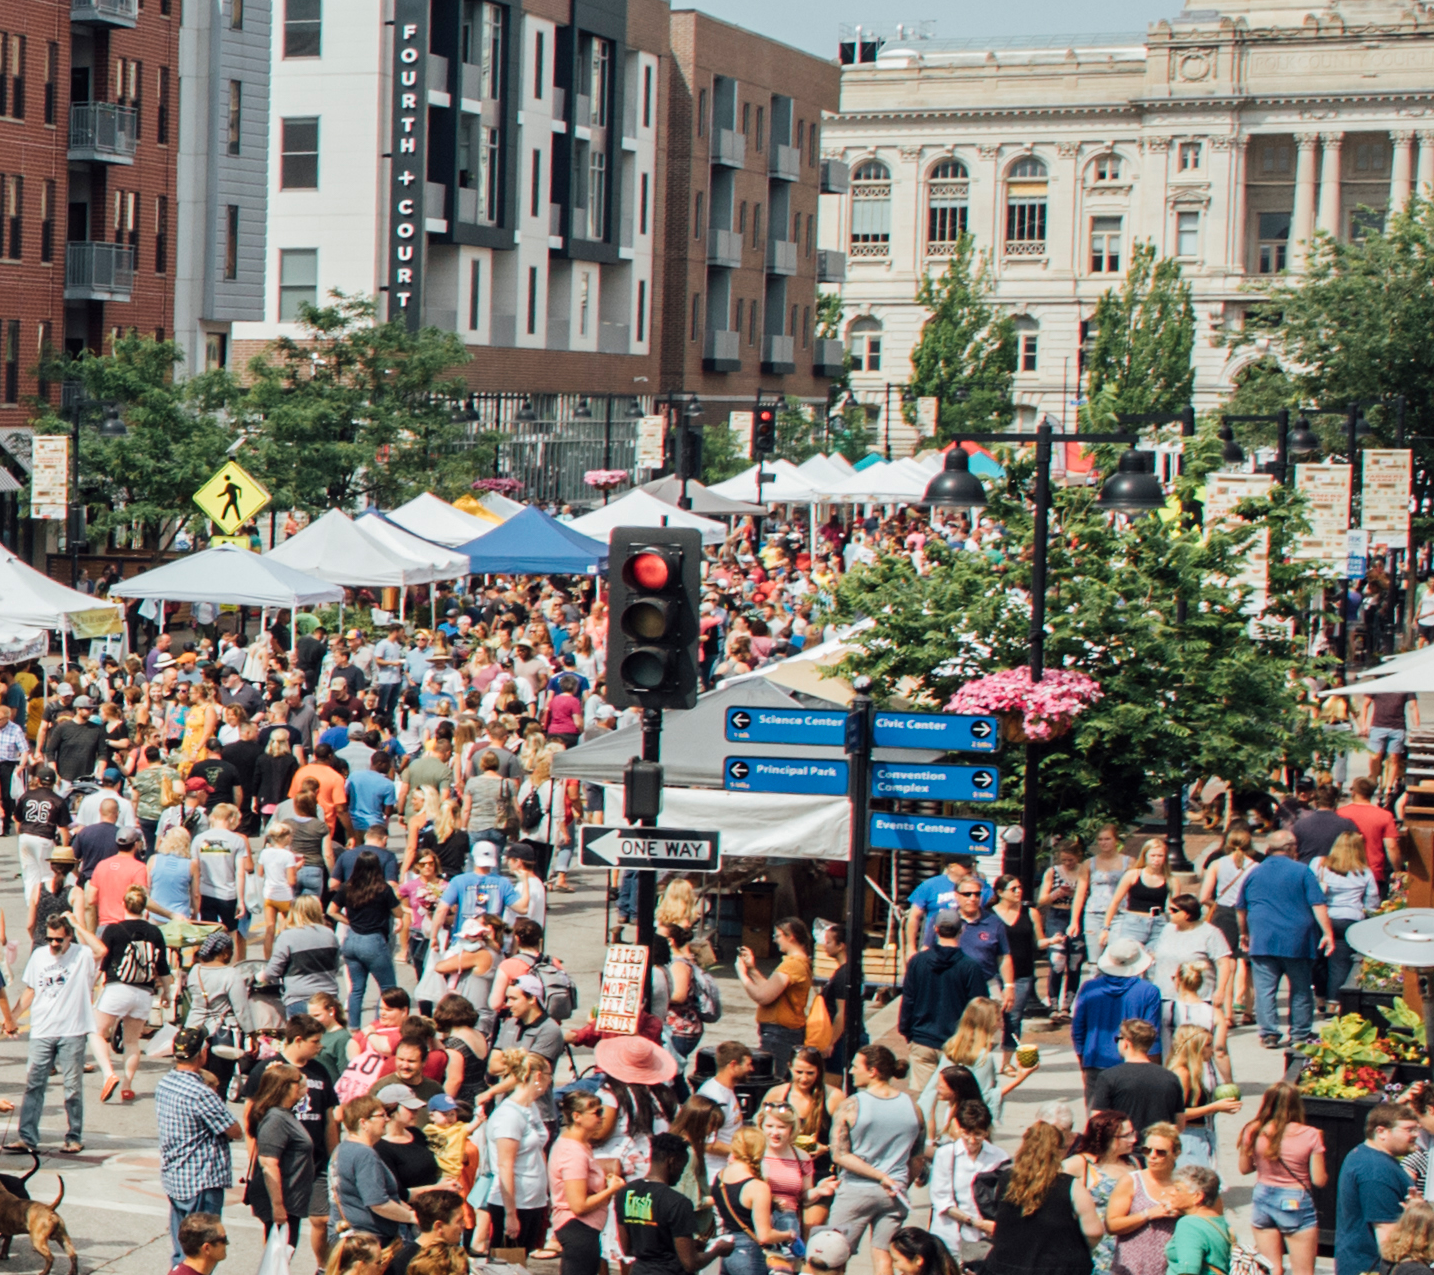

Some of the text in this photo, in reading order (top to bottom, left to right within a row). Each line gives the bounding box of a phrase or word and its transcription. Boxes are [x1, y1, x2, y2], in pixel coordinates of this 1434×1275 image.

[400, 25, 418, 154] FOURTH
[396, 199, 415, 307] COURT
[758, 713, 844, 727] Science Center
[875, 718, 947, 731] Civic Center
[756, 764, 837, 777] Principal Park
[877, 769, 947, 781] Convention
[877, 782, 930, 795] Complex
[25, 800, 52, 824] 26
[875, 819, 958, 835] Events Center
[621, 839, 703, 859] ONE WAY
